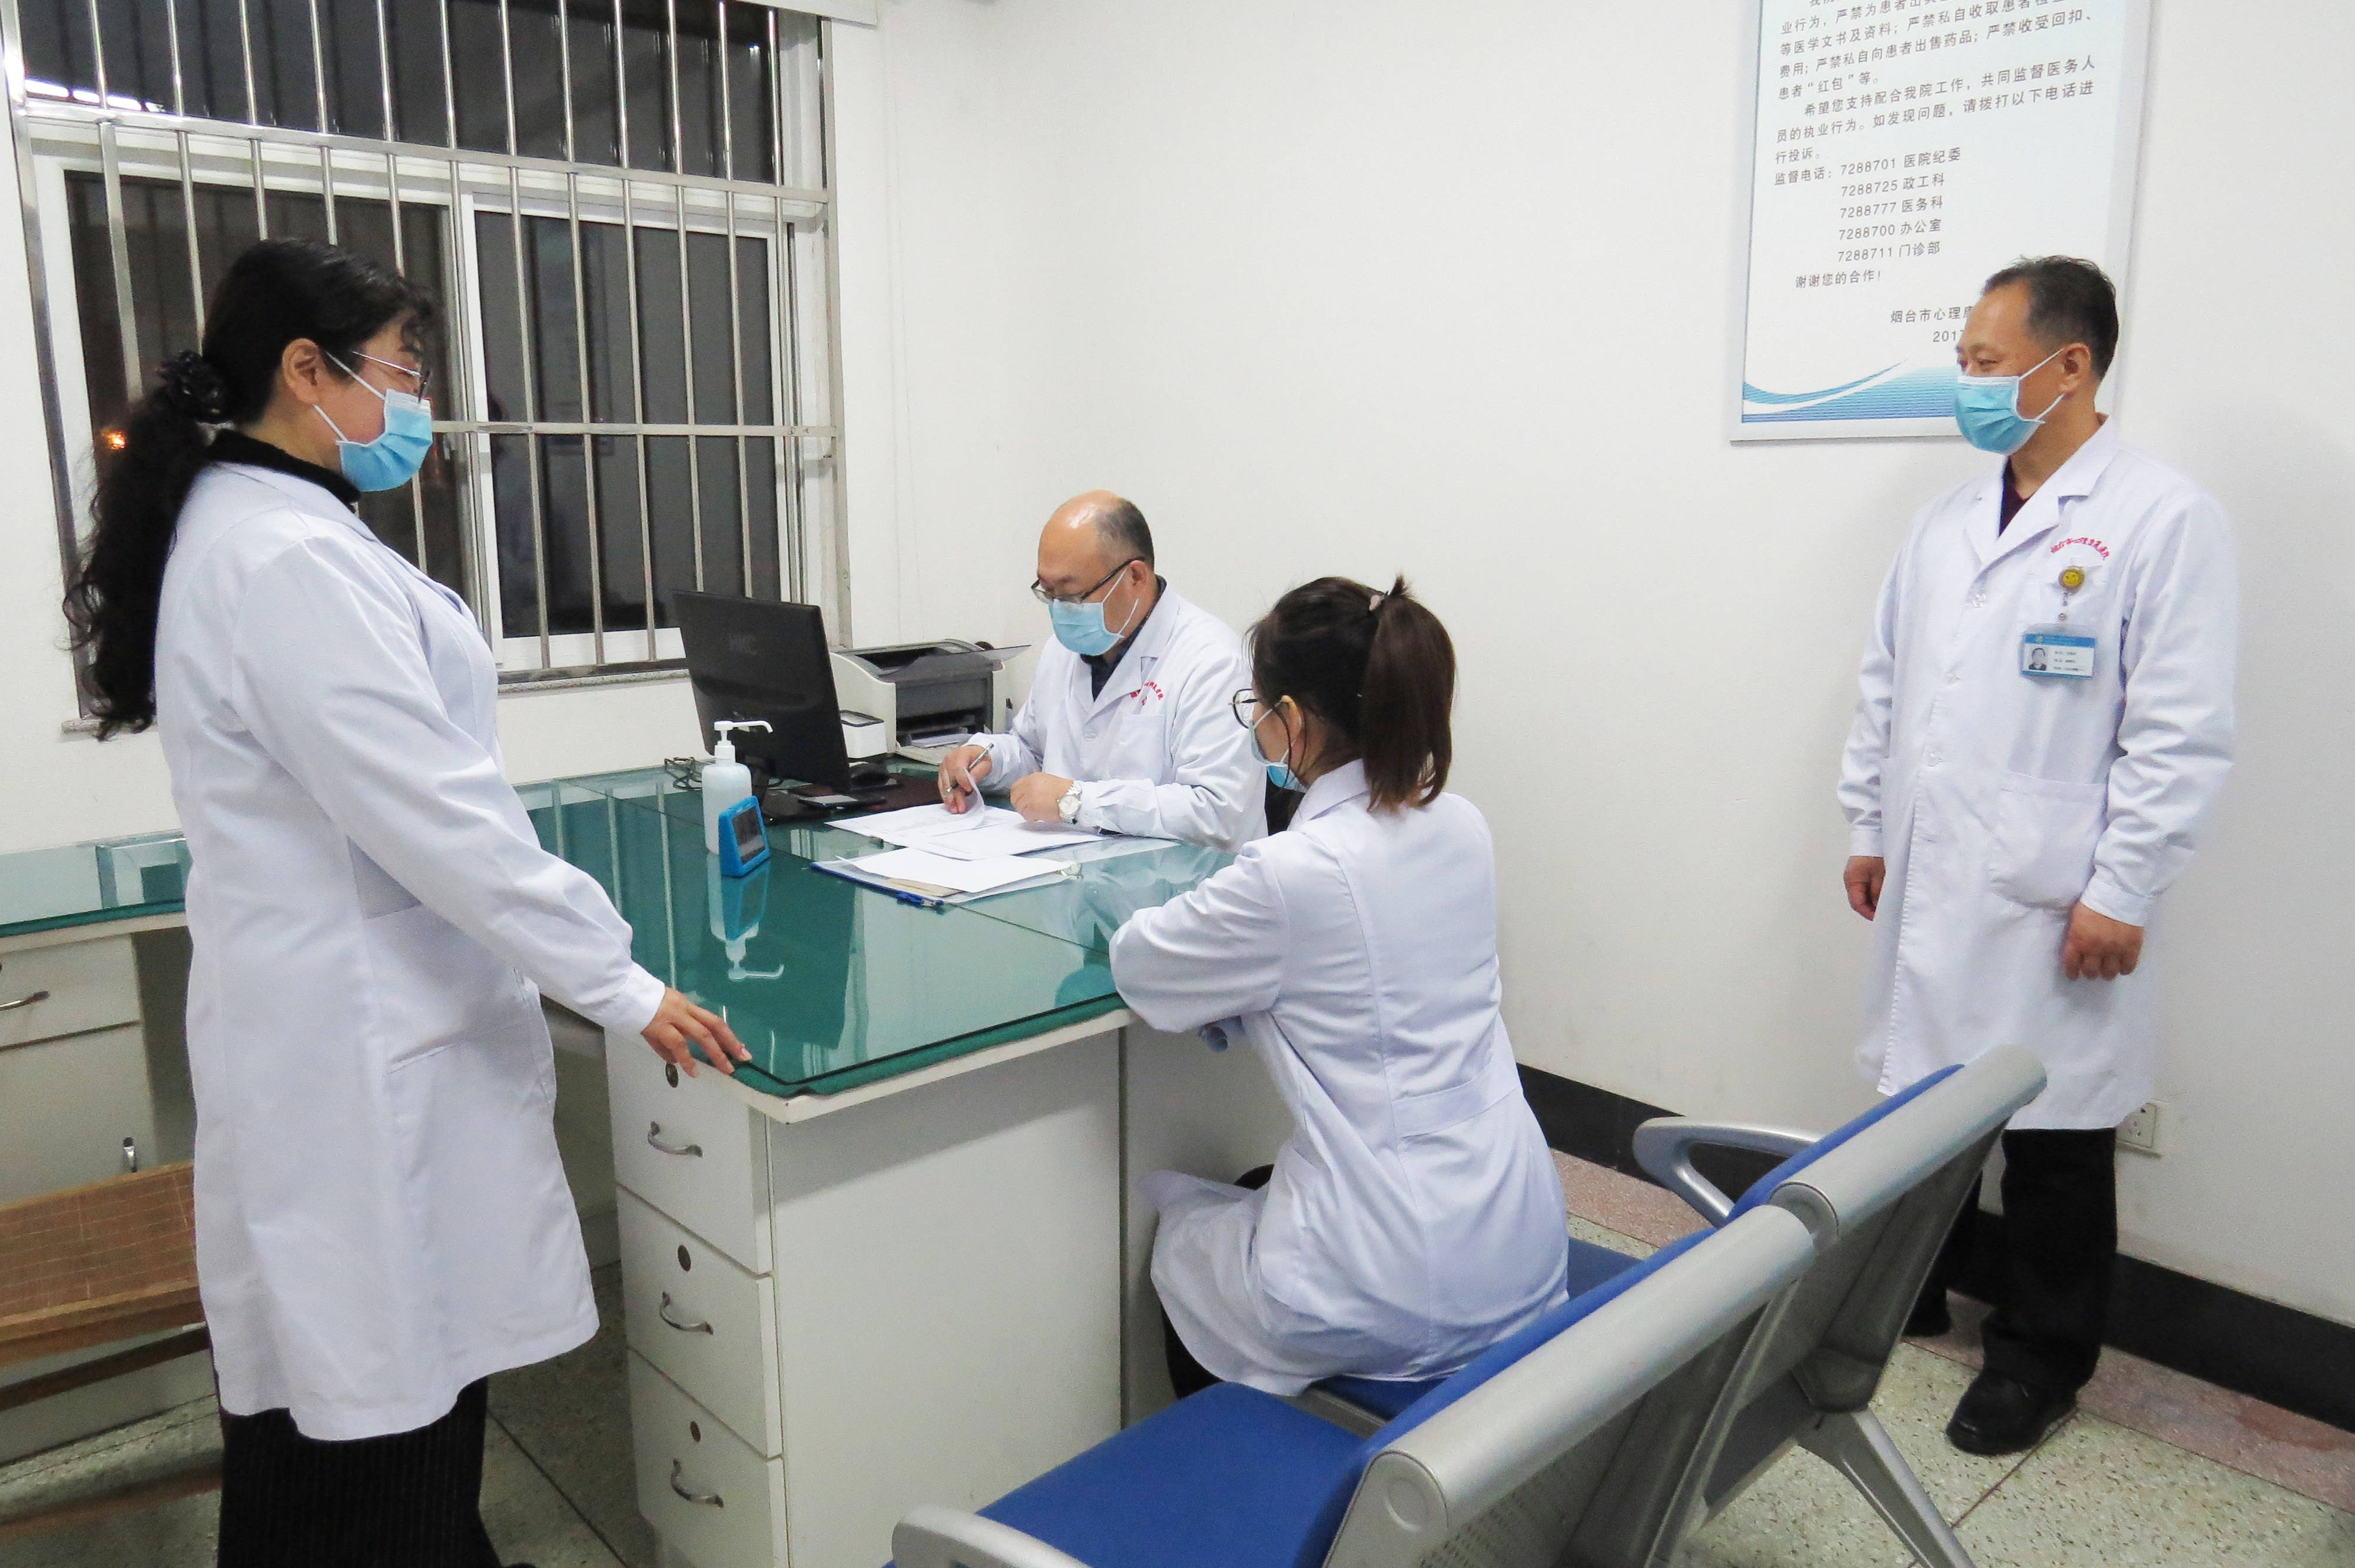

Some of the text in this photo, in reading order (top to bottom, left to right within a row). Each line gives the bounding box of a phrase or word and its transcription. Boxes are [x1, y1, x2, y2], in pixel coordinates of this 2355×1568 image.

[1804, 55, 2096, 117] 希望您支持配合我院工作，共同监督医务人
[1776, 80, 2095, 143] 员的执业行为。如发现问题，请拨打以下电话进
[1775, 147, 1821, 164] 行投诉。
[1840, 158, 1896, 175] 7288701
[1903, 147, 1961, 168] 医院纪委
[1841, 172, 1945, 197] 7288725 政工科
[1839, 195, 1943, 218] 7288777 医务科
[1838, 218, 1942, 240] 7288700 办公室
[1837, 240, 1941, 263] 7288711 门诊部
[1795, 269, 1882, 288] 谢谢您的合作！
[1932, 329, 1964, 343] 201
